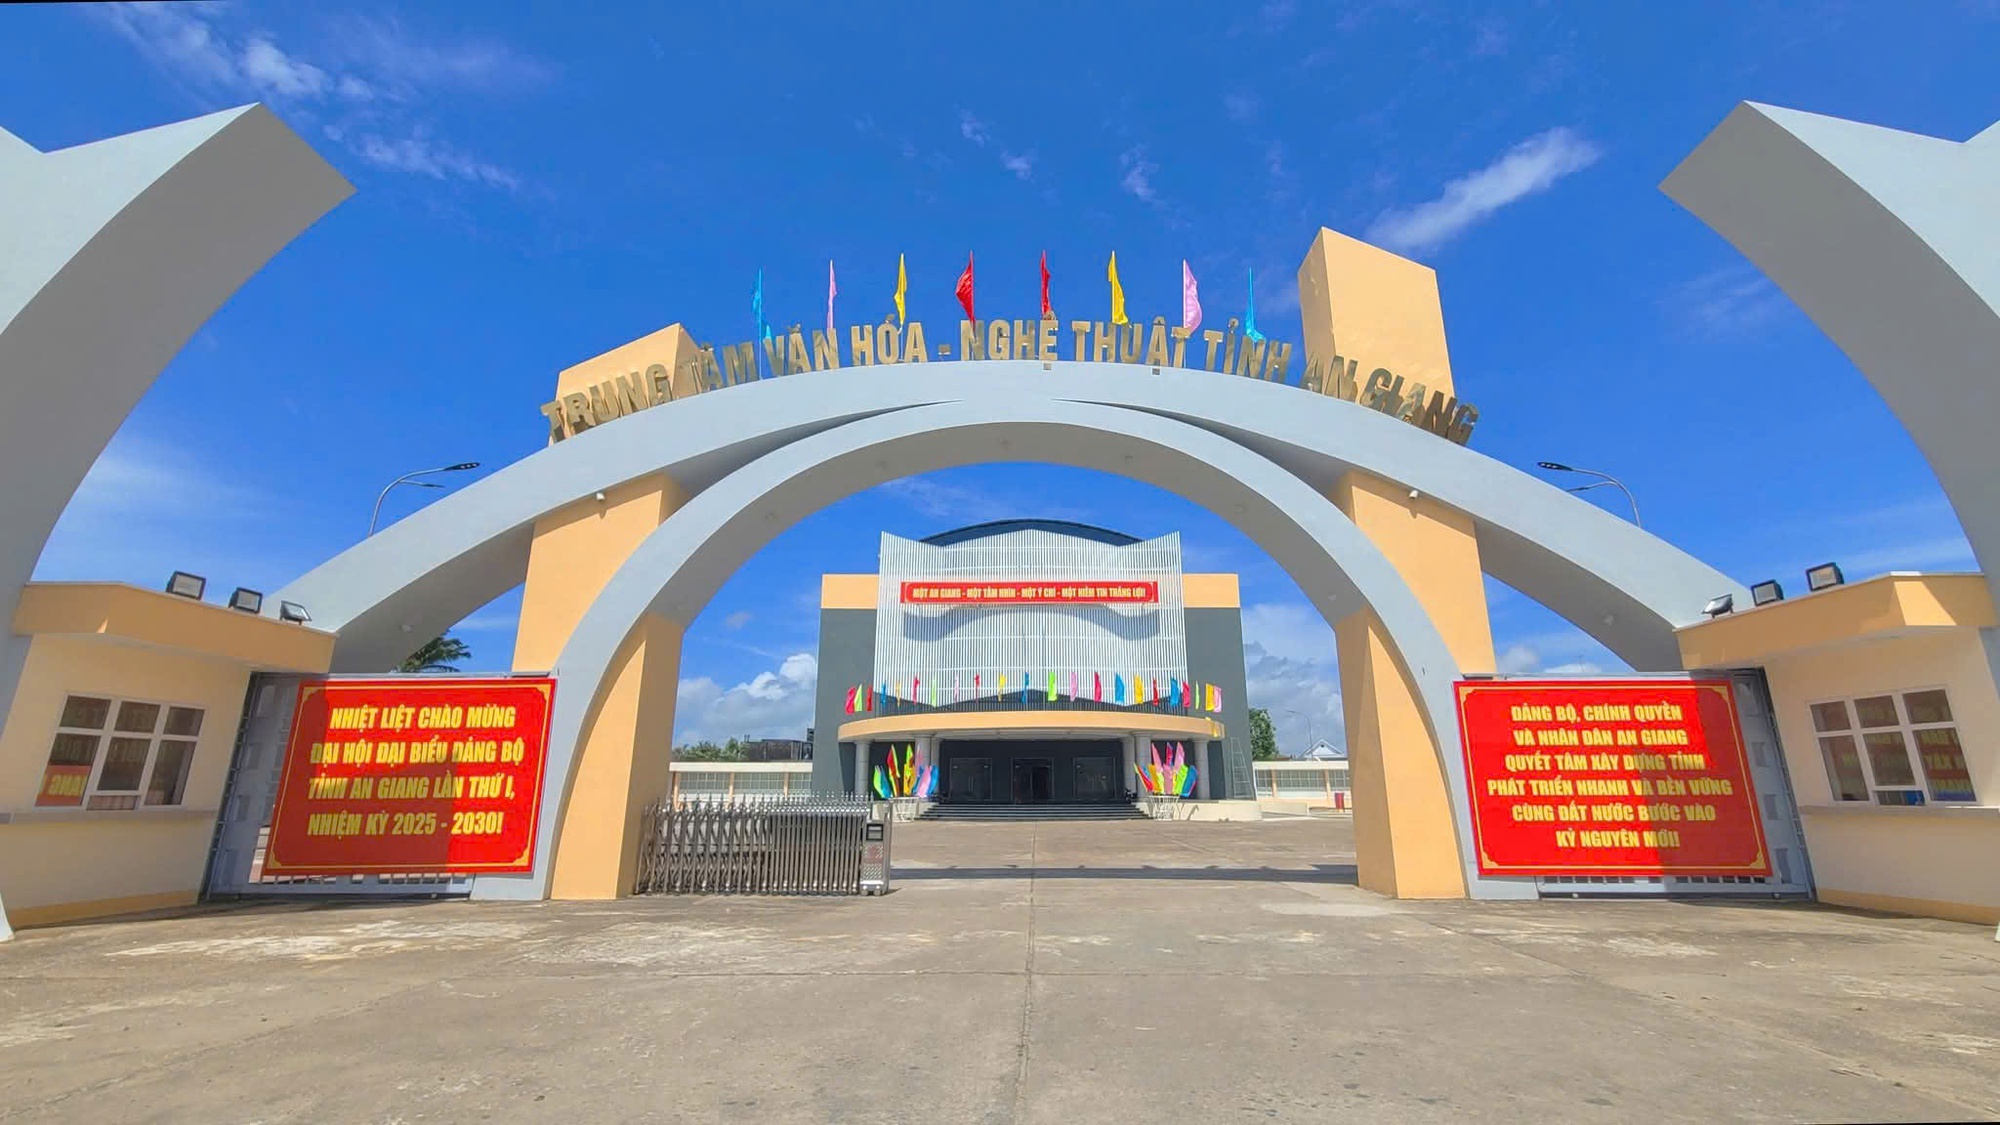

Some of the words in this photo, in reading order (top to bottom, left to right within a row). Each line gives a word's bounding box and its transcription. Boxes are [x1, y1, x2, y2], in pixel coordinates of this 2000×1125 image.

[541, 363, 673, 446] TRUNG
[676, 342, 759, 394] TÂM
[763, 325, 840, 377] VĂN
[960, 312, 1059, 370] NGHỆ
[1072, 316, 1189, 375] THUẬT
[1203, 318, 1292, 384] TỈNH
[1299, 352, 1358, 401] AN
[1360, 367, 1479, 447] GIANG
[330, 704, 378, 733] NHIỆT
[381, 704, 415, 733] LIỆT
[418, 704, 462, 728] CHÀO
[466, 704, 516, 728] MỪNG
[1511, 703, 1552, 722] ĐẢNG
[1555, 703, 1580, 724] BỘ,
[1583, 704, 1631, 721] CHÍNH
[1634, 701, 1682, 722] QUYỀN
[1514, 728, 1536, 746] VÀ
[1538, 728, 1580, 746] NHÂN
[1582, 728, 1614, 746] DÂN
[1617, 730, 1638, 746] AN
[1641, 730, 1688, 746] GIANG
[310, 742, 340, 768] ĐẠI
[342, 739, 373, 768] HỘI
[376, 742, 406, 768] ĐẠI
[410, 734, 448, 763] BIỂU
[452, 736, 497, 762] ĐẢNG
[501, 737, 524, 766] BỘ
[1505, 750, 1552, 772] QUYẾT
[1554, 752, 1588, 771] TÂM
[1590, 752, 1618, 771] XÂY
[1623, 753, 1666, 774] DỰNG
[1668, 751, 1706, 771] TỈNH
[308, 773, 348, 799] TỈNH
[350, 777, 373, 799] AN
[378, 777, 429, 799] GIANG
[433, 770, 464, 798] LẦN
[468, 772, 504, 798] THỨ
[505, 776, 515, 800] I,
[1487, 777, 1526, 796] PHÁT
[1529, 775, 1574, 796] TRIỂN
[1576, 780, 1629, 796] NHANH
[1632, 778, 1654, 796] VÀ
[1656, 775, 1686, 796] BỀN
[1689, 778, 1733, 796] VỮNG
[1512, 802, 1555, 822] CÙNG
[1558, 800, 1587, 822] ĐẤT
[1591, 802, 1634, 822] NƯỚC
[1638, 802, 1681, 822] BƯỚC
[1684, 803, 1716, 821] VÀO
[308, 811, 362, 840] NHIỆM
[365, 810, 389, 835] KỲ
[392, 812, 436, 835] 2025
[451, 811, 504, 835] 2030!
[1580, 828, 1640, 848] NGUYÊN
[1643, 828, 1680, 847] MỚI!
